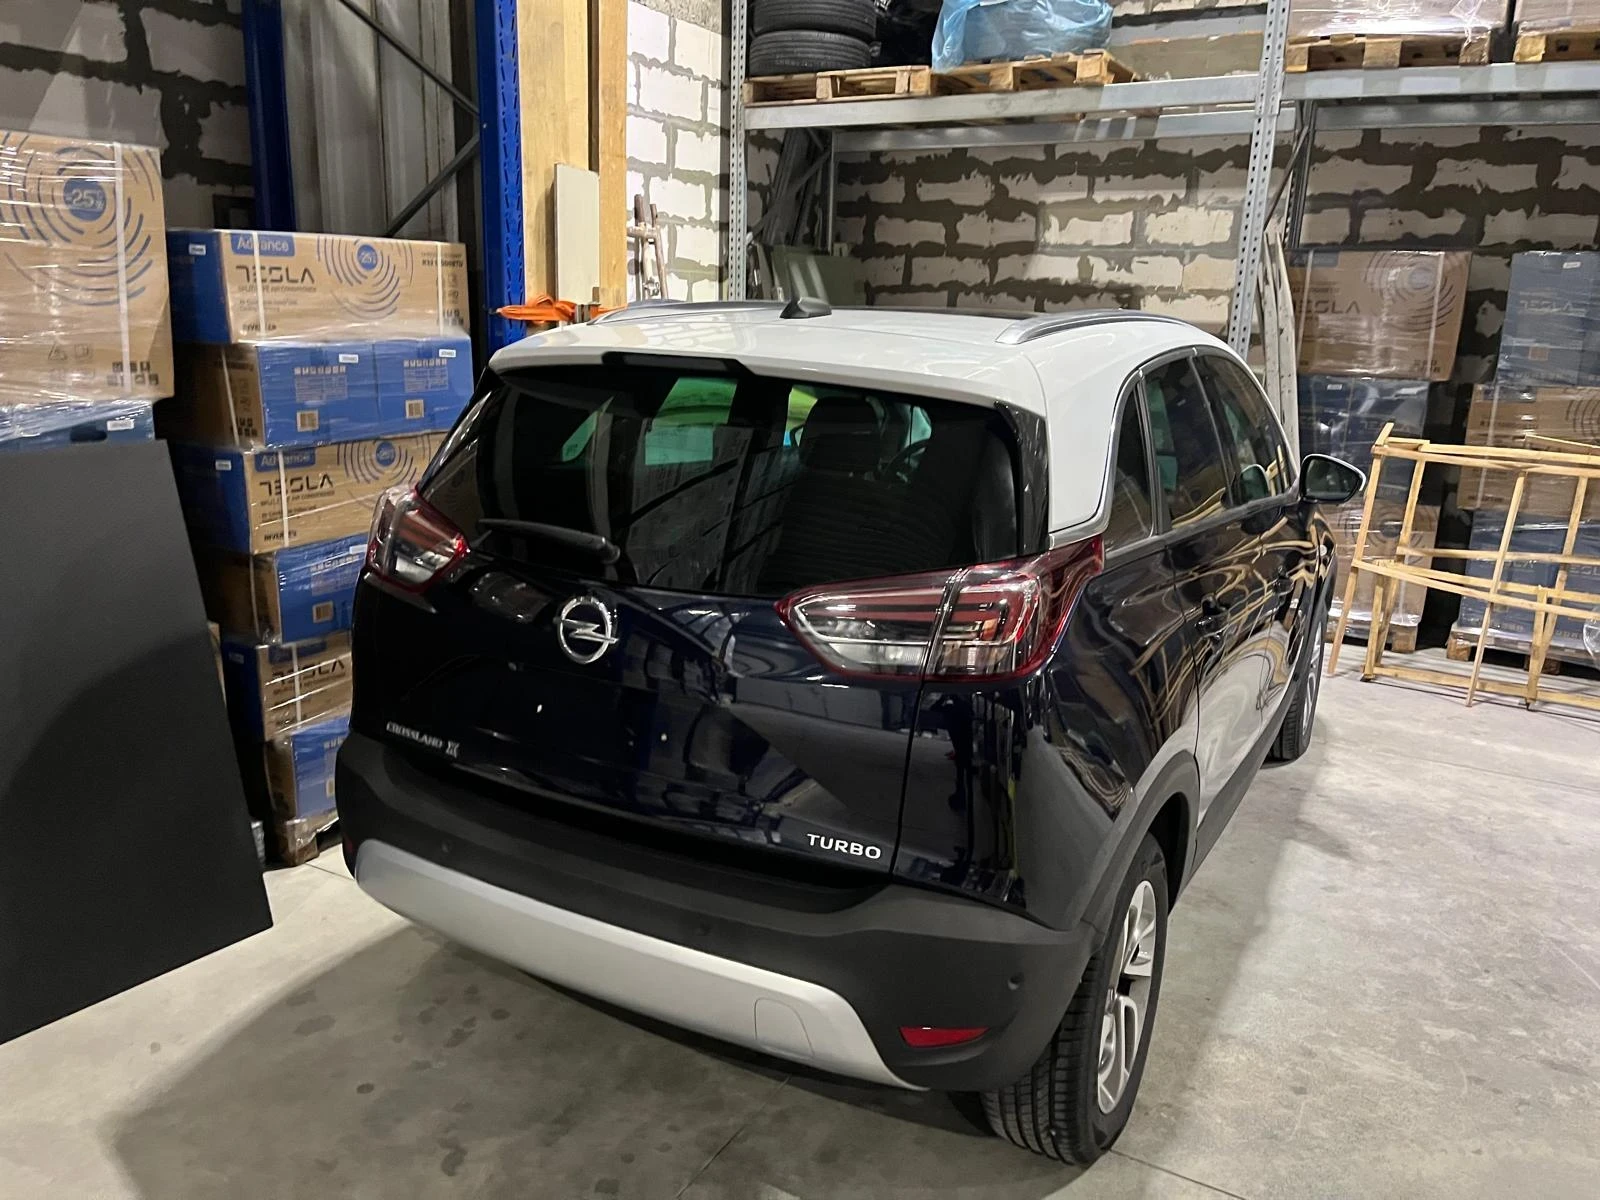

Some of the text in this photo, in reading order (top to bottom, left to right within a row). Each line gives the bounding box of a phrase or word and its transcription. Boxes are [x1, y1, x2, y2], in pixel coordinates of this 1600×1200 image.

[237, 234, 289, 252] Adance
[236, 265, 315, 284] TESLA
[261, 453, 310, 467] Adance
[259, 473, 334, 496] TESLA
[807, 833, 881, 859] TURBO
